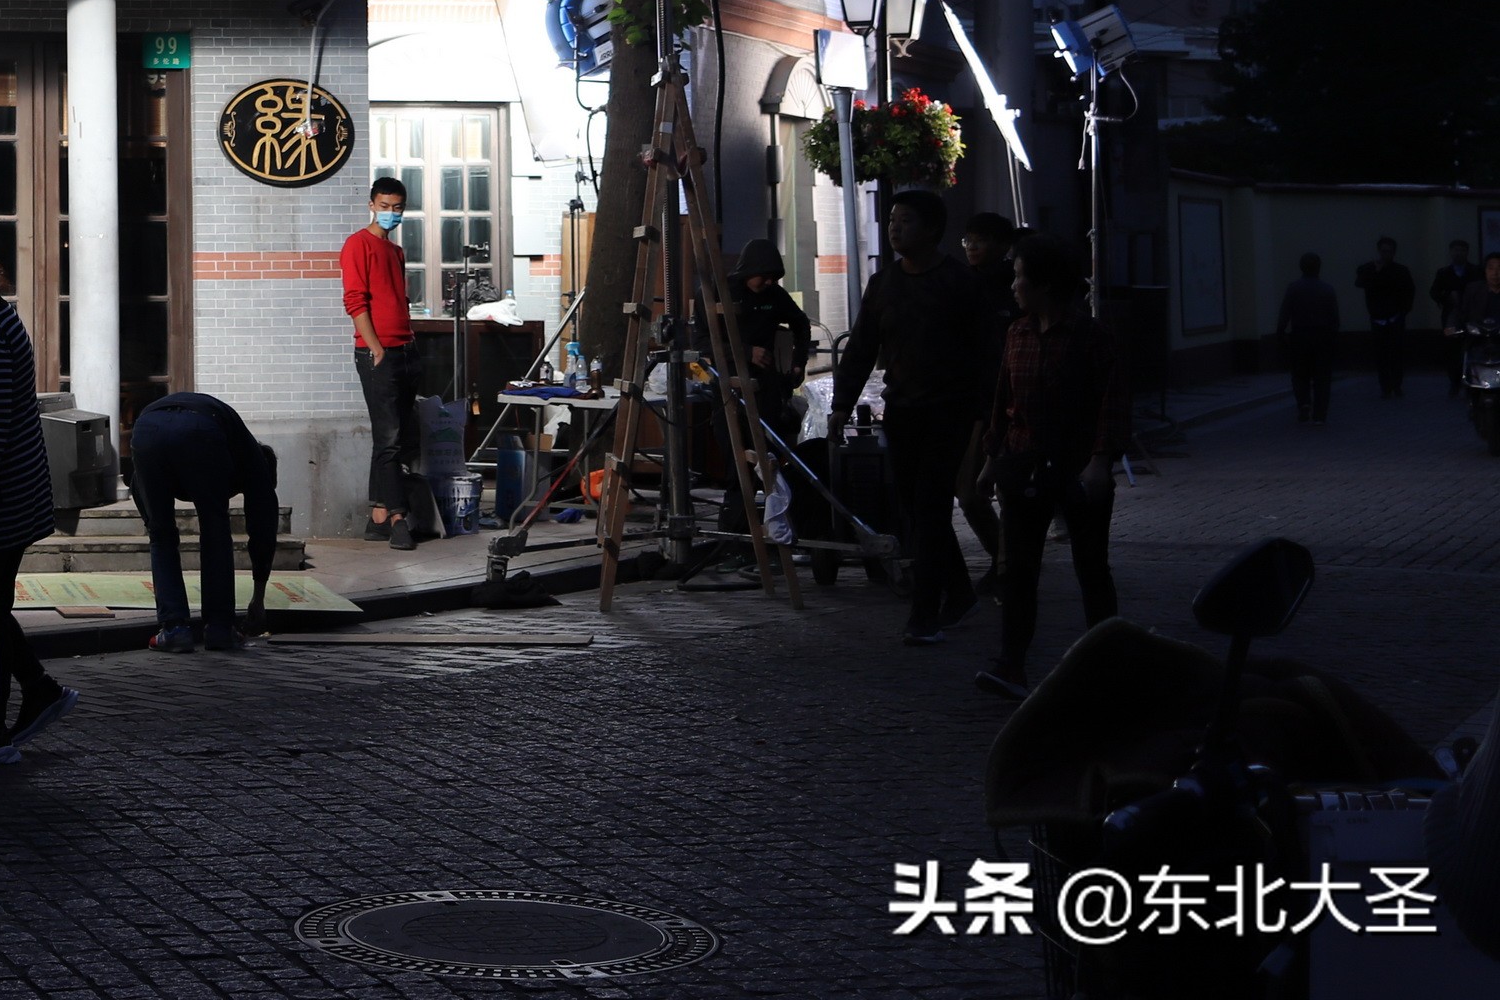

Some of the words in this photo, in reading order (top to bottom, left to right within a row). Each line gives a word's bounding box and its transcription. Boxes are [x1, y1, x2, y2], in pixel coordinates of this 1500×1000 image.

[155, 36, 177, 55] 99
[153, 57, 180, 65] 多伦路
